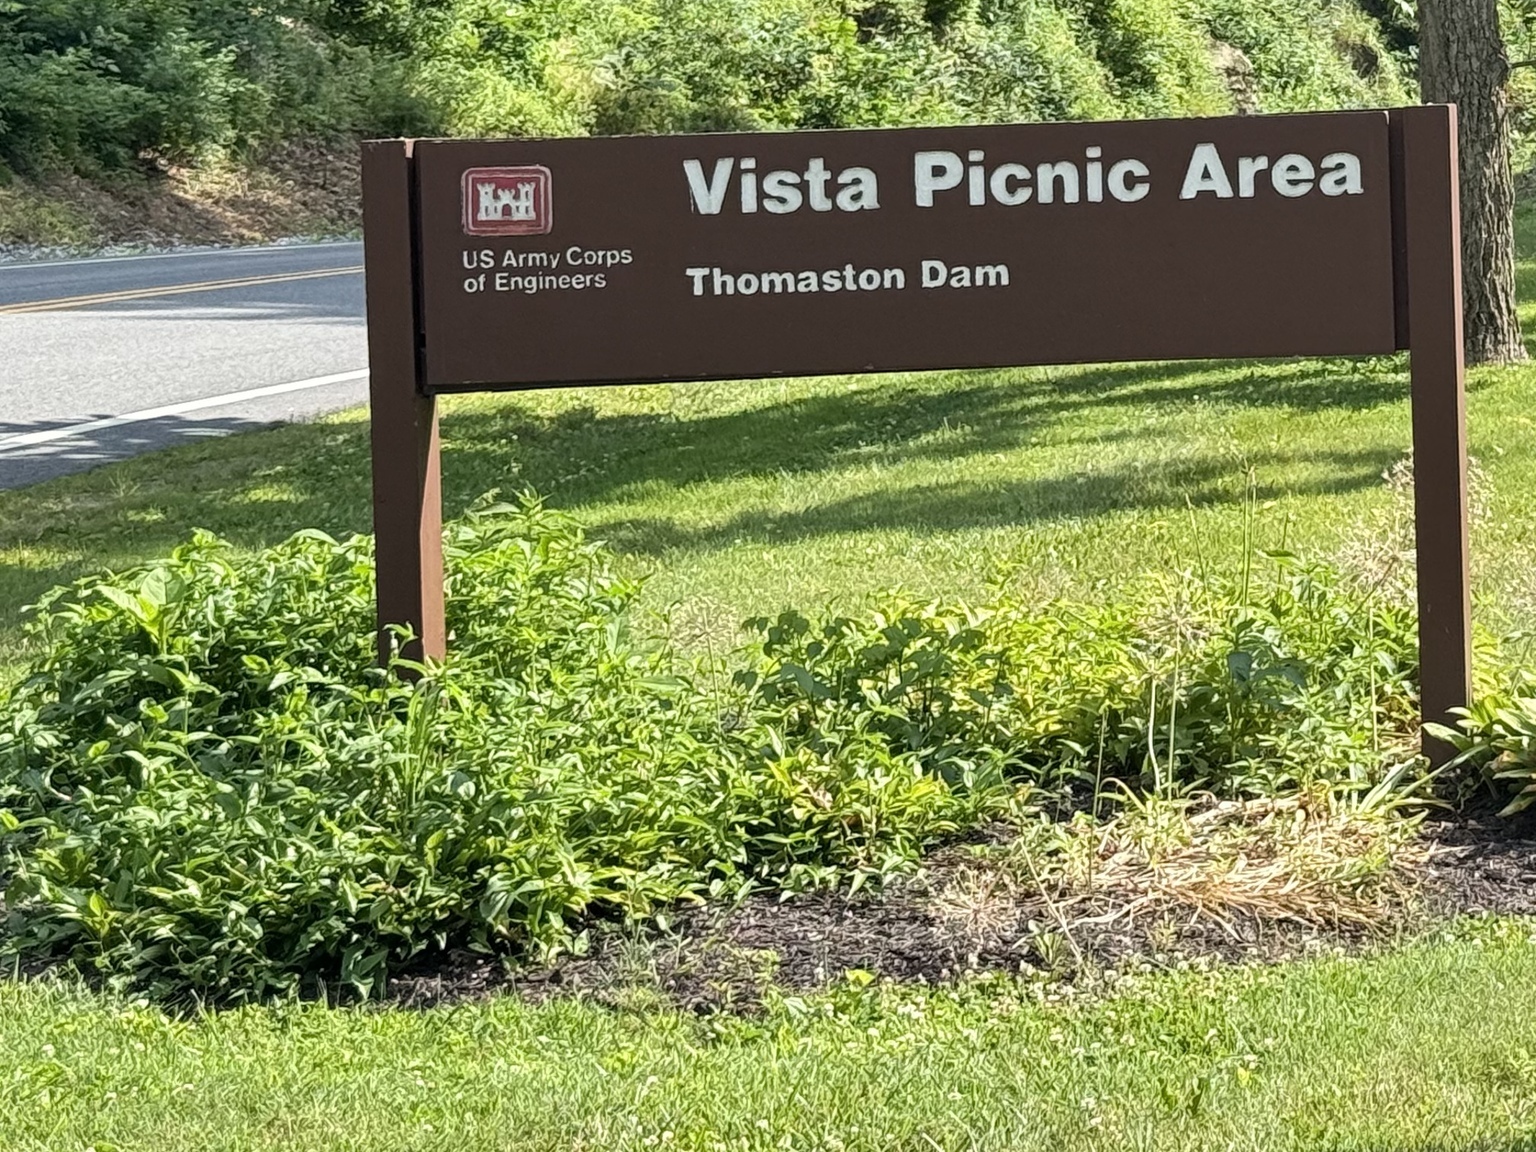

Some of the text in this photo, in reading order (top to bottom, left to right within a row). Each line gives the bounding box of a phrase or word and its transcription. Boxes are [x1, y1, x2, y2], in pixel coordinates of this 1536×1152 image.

[682, 142, 1365, 215] Vista Picnic Area
[462, 246, 633, 270] US Army Corps
[463, 270, 607, 295] of Engineers
[685, 259, 1010, 296] Thomaston Dam
